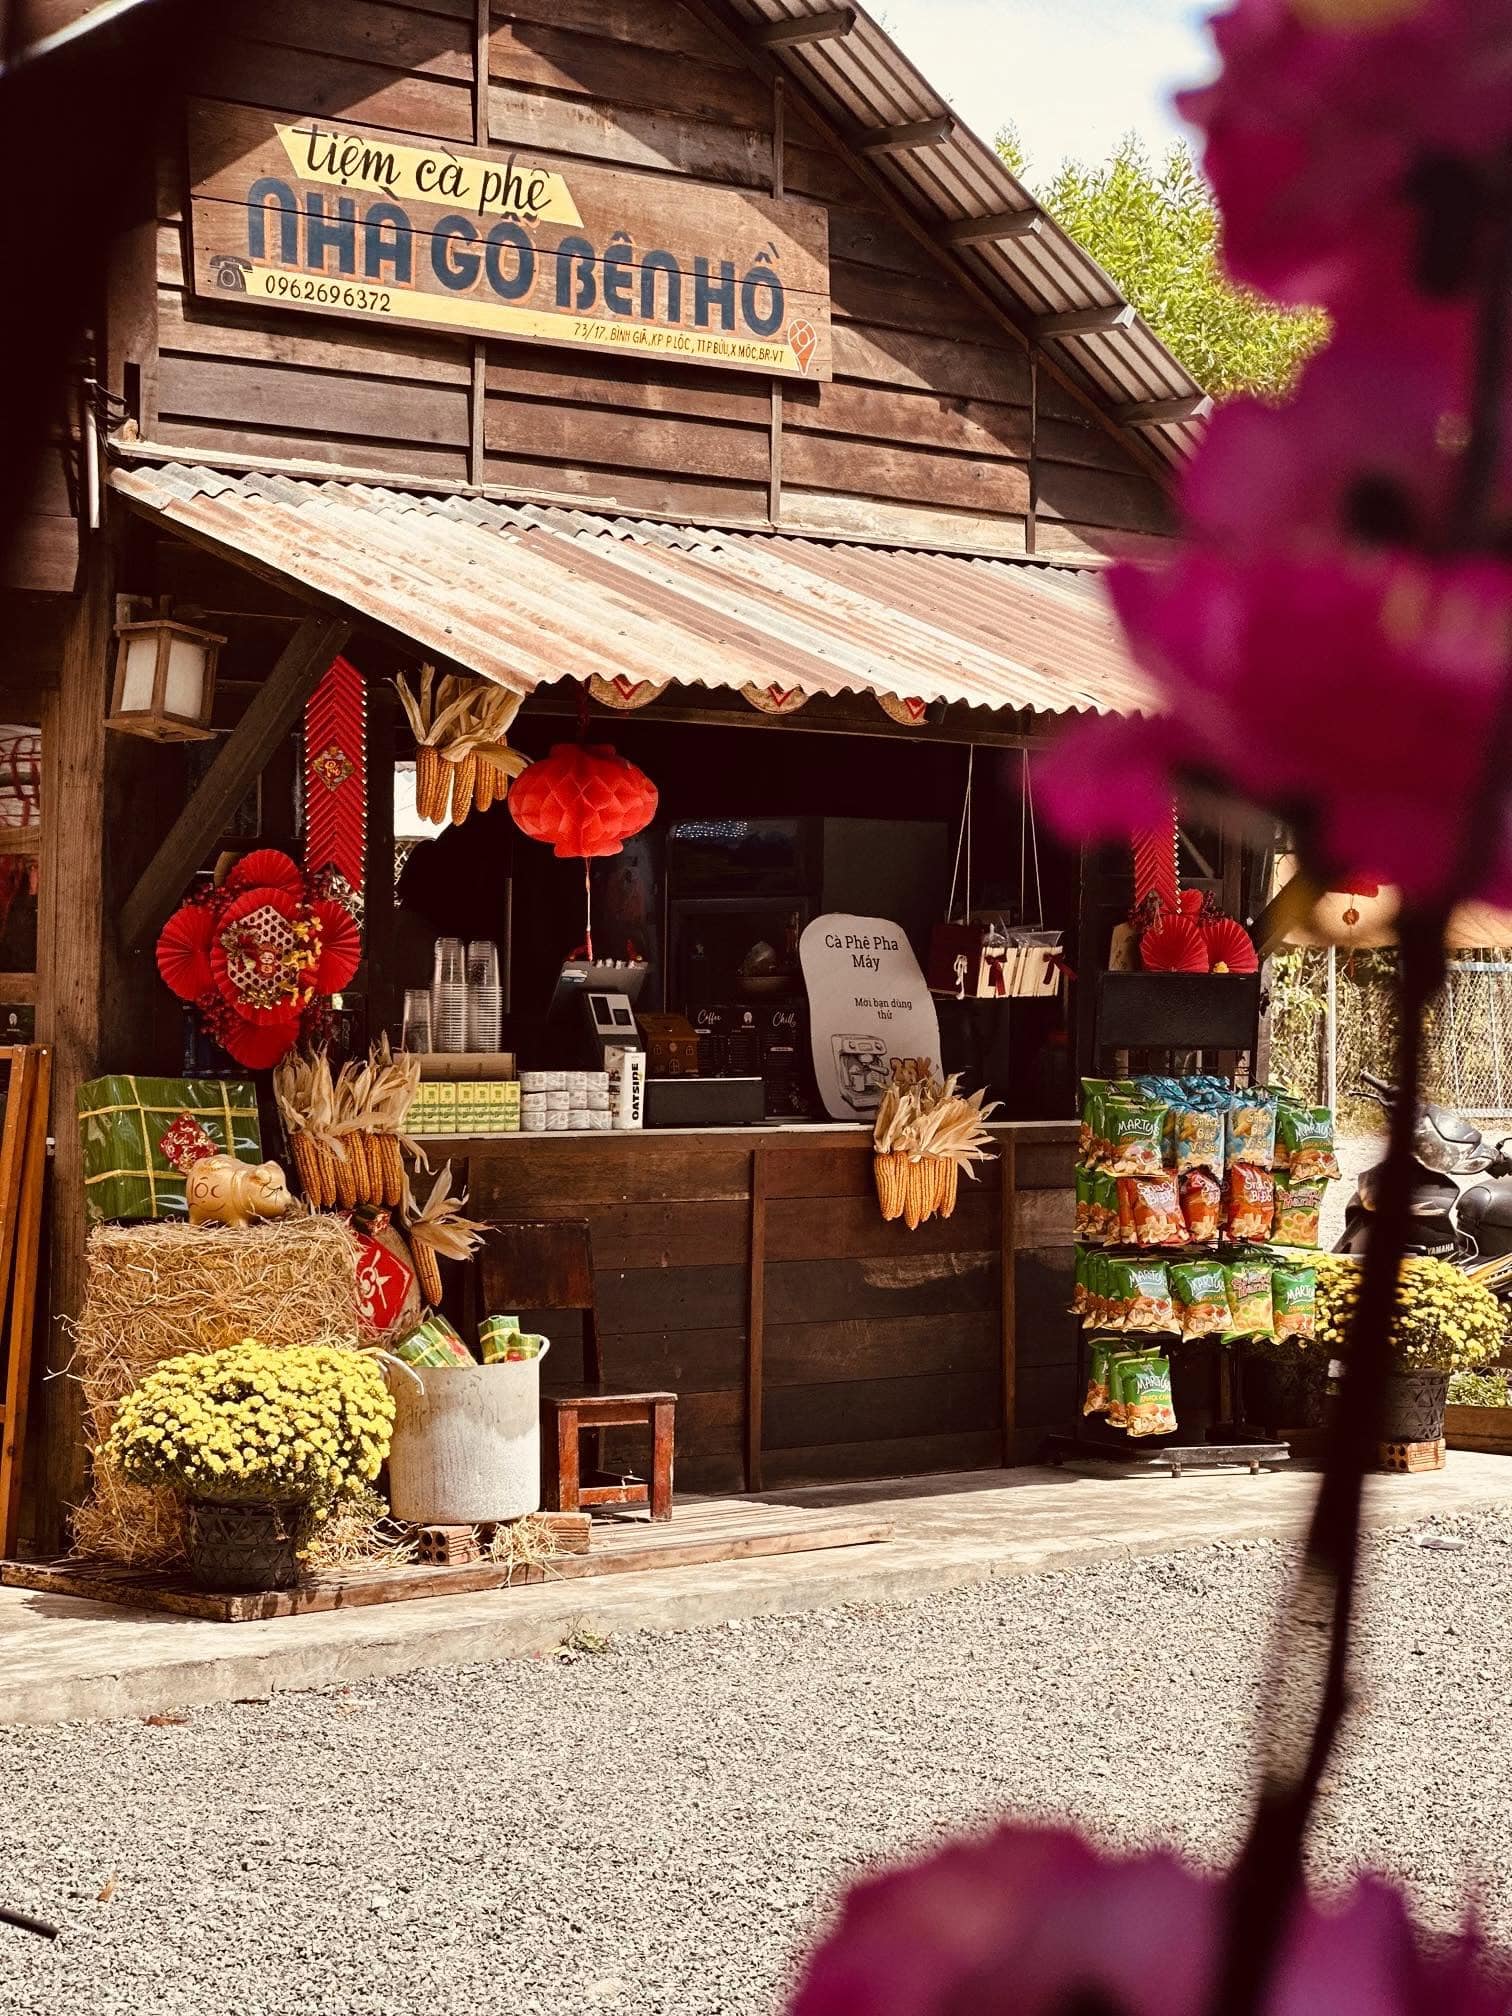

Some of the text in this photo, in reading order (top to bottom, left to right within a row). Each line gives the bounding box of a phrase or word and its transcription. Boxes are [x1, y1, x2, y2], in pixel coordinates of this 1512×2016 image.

[291, 124, 552, 216] tiệm cà phê
[249, 176, 786, 337] NHÀ GỖ BÊN HỒ
[825, 934, 899, 951] Cà Phê Pha
[852, 954, 880, 972] Máy
[697, 1009, 722, 1026] Coffee
[631, 1063, 640, 1121] OATSIDE
[1427, 1242, 1455, 1256] YAMAHA
